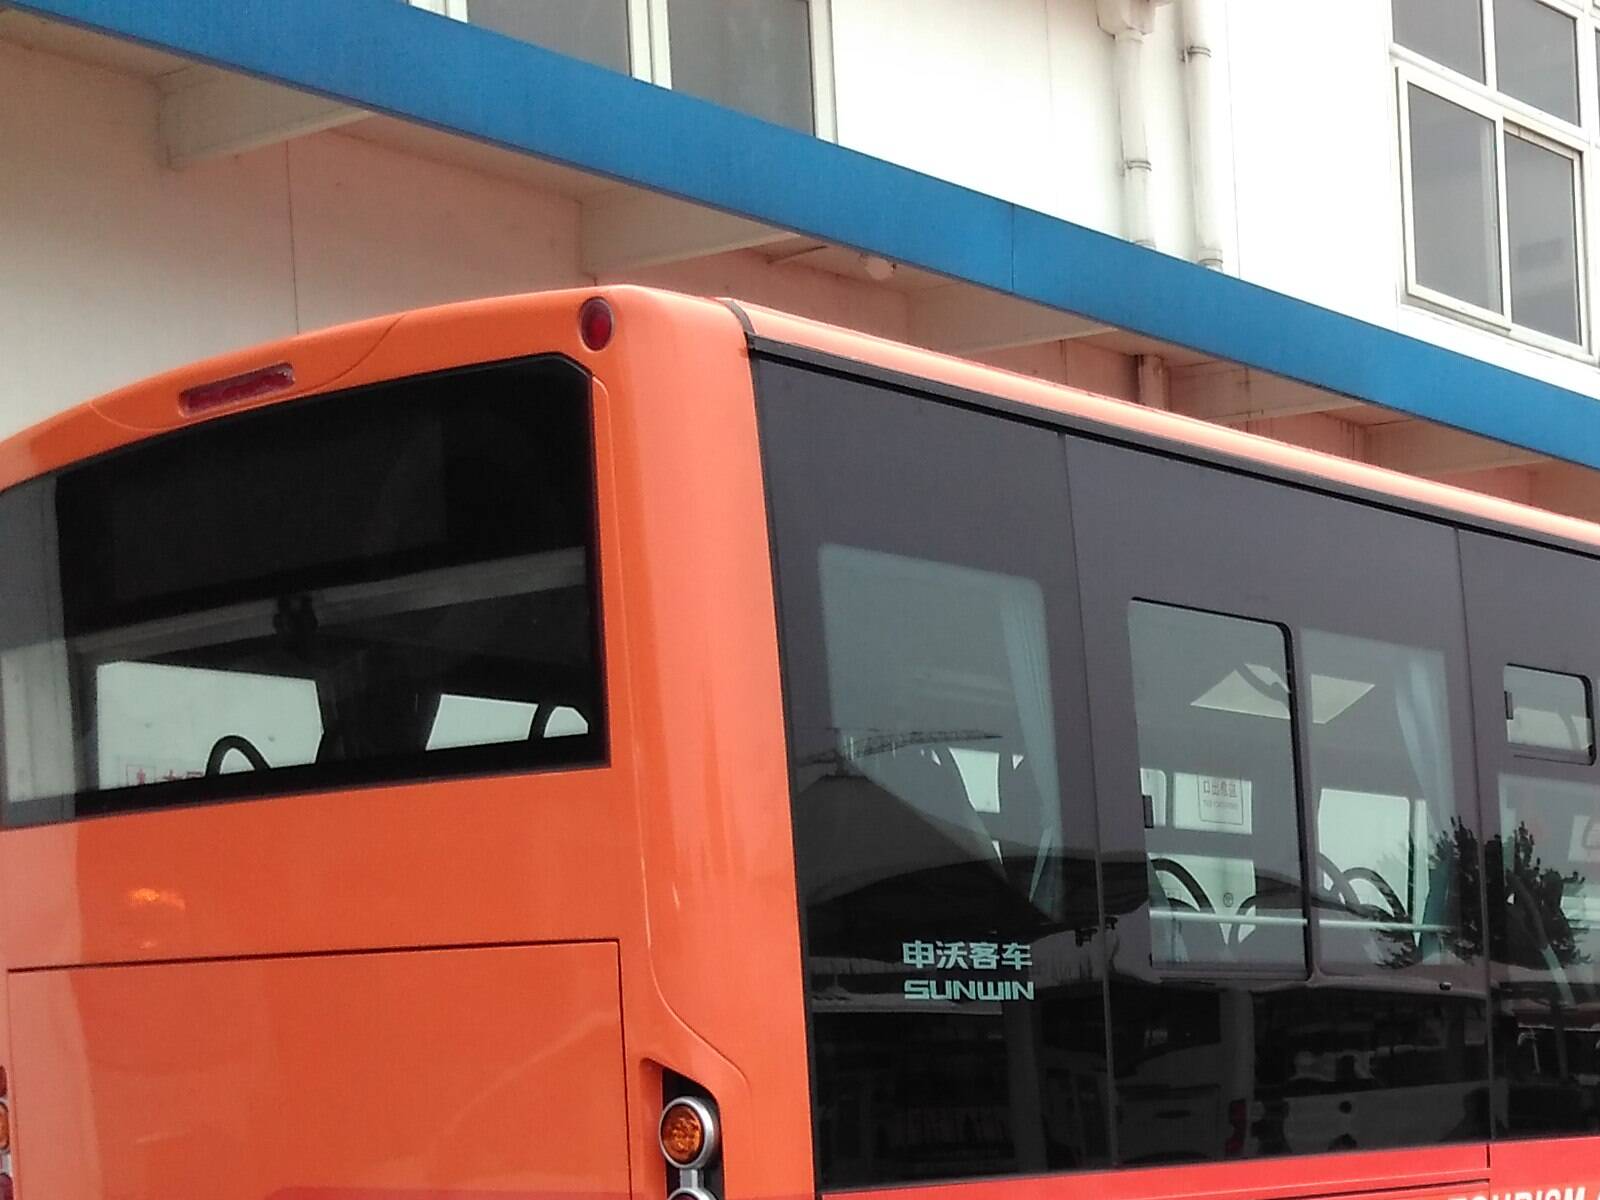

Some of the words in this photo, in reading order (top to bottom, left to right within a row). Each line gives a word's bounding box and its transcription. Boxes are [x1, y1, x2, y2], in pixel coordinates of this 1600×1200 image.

[902, 940, 1033, 971] 申沃客车
[904, 979, 1035, 1000] SUNWIN
